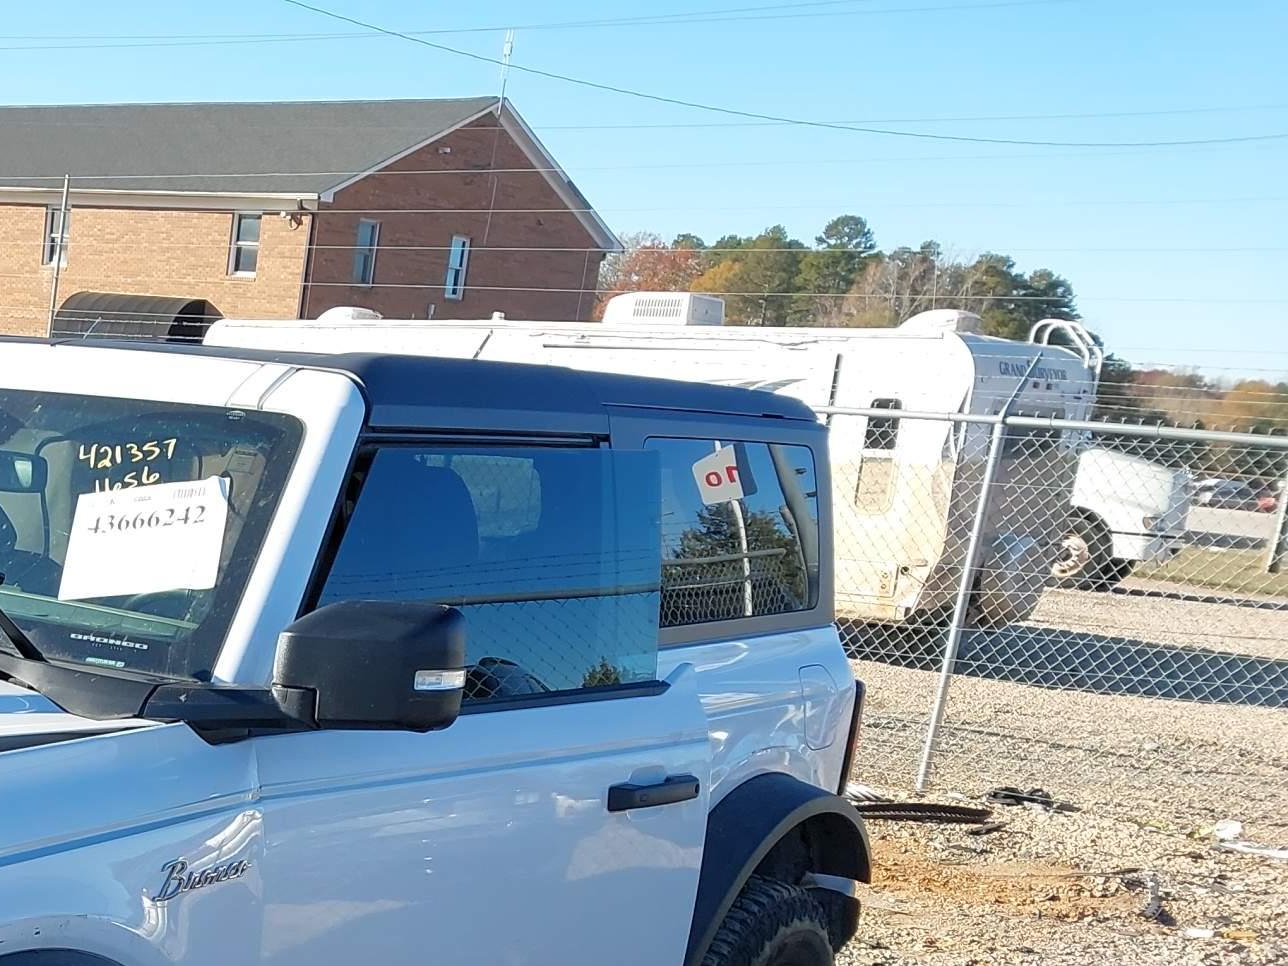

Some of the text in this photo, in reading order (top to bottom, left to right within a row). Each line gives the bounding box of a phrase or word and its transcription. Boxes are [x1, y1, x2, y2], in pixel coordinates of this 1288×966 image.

[79, 438, 177, 468] 421357
[87, 505, 206, 534] 43666242
[152, 858, 252, 902] Bronco
